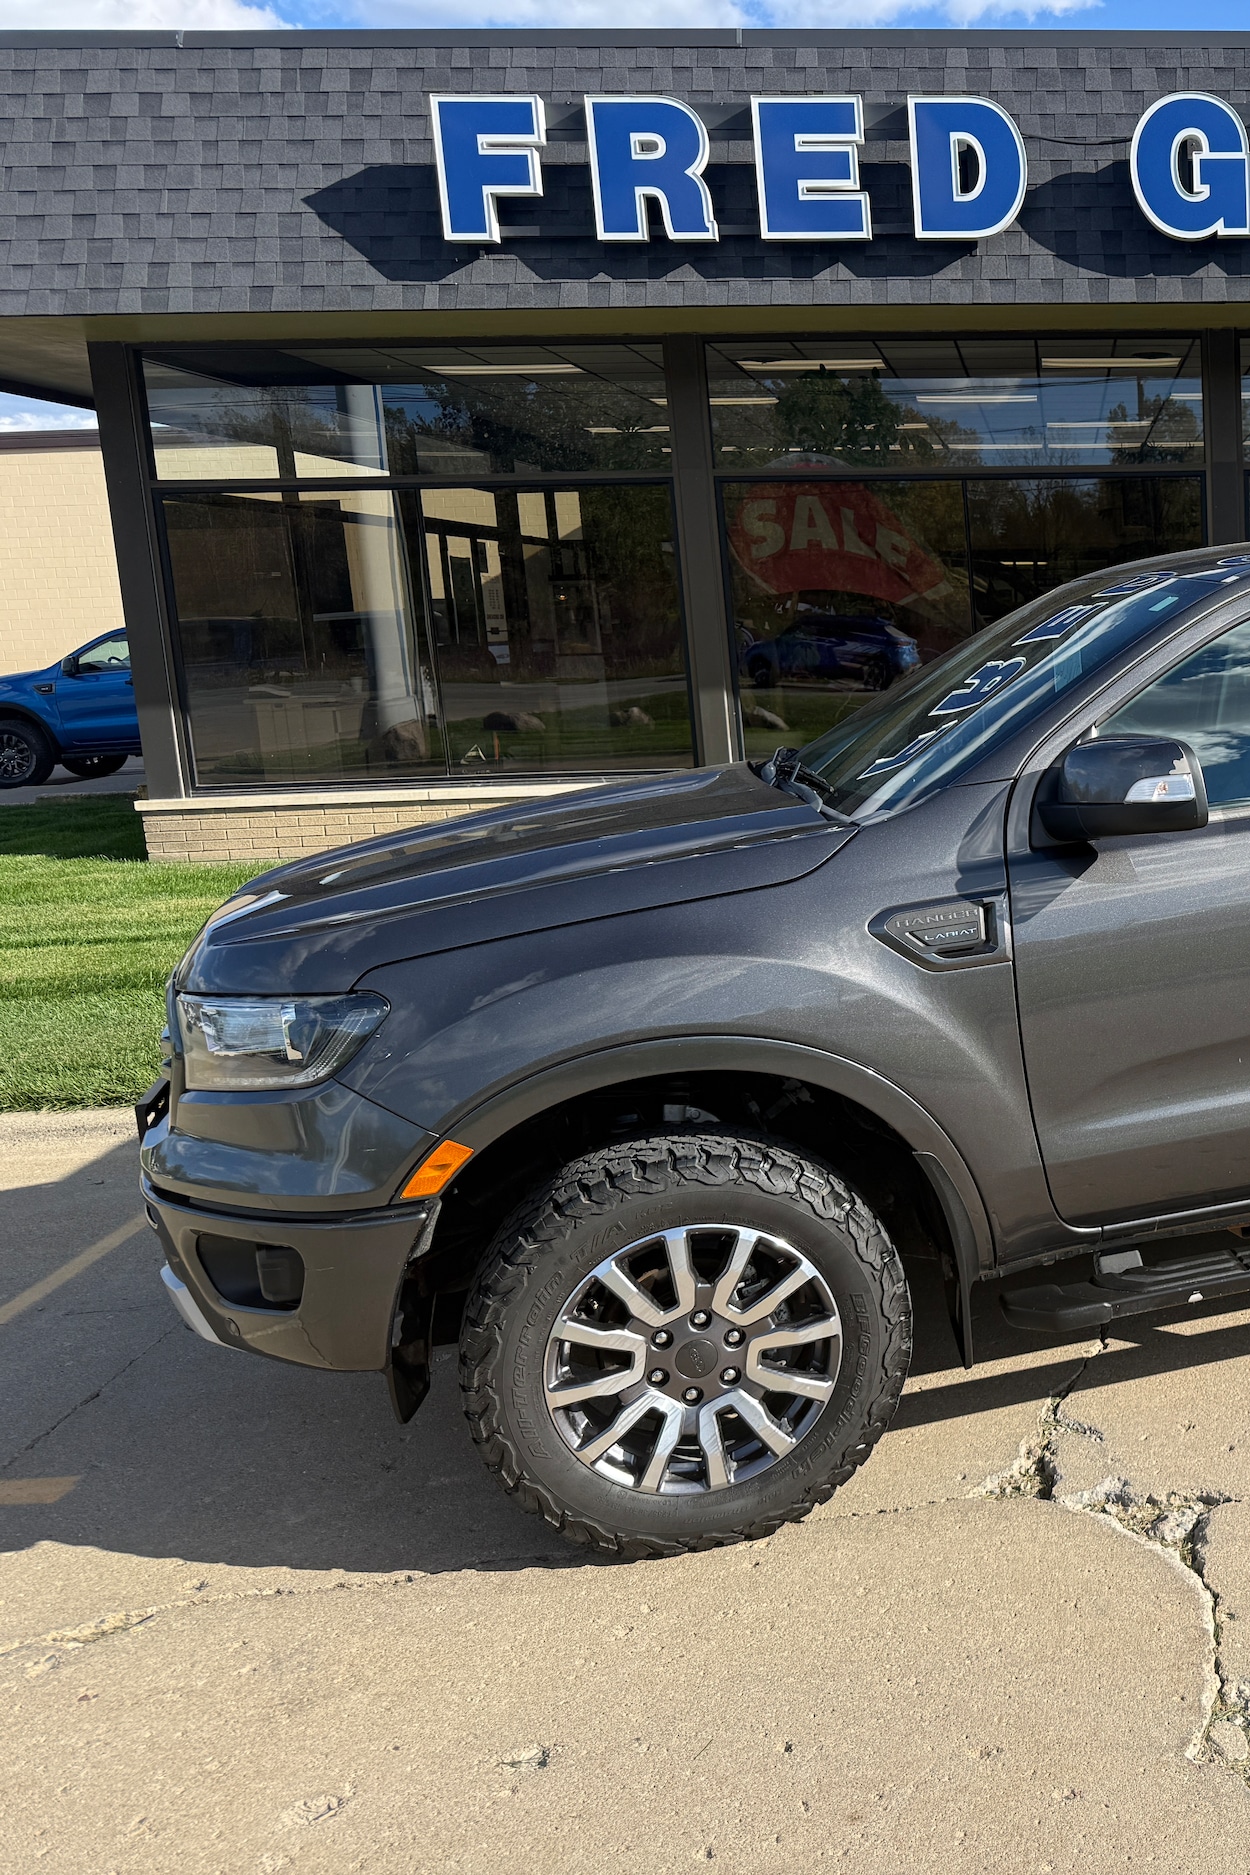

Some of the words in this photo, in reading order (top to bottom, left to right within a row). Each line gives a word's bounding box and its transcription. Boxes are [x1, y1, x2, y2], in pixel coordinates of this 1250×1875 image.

[429, 93, 1028, 243] FRED
[742, 495, 912, 582] SALE
[895, 909, 978, 928] RANGER
[924, 927, 977, 941] LARIAT
